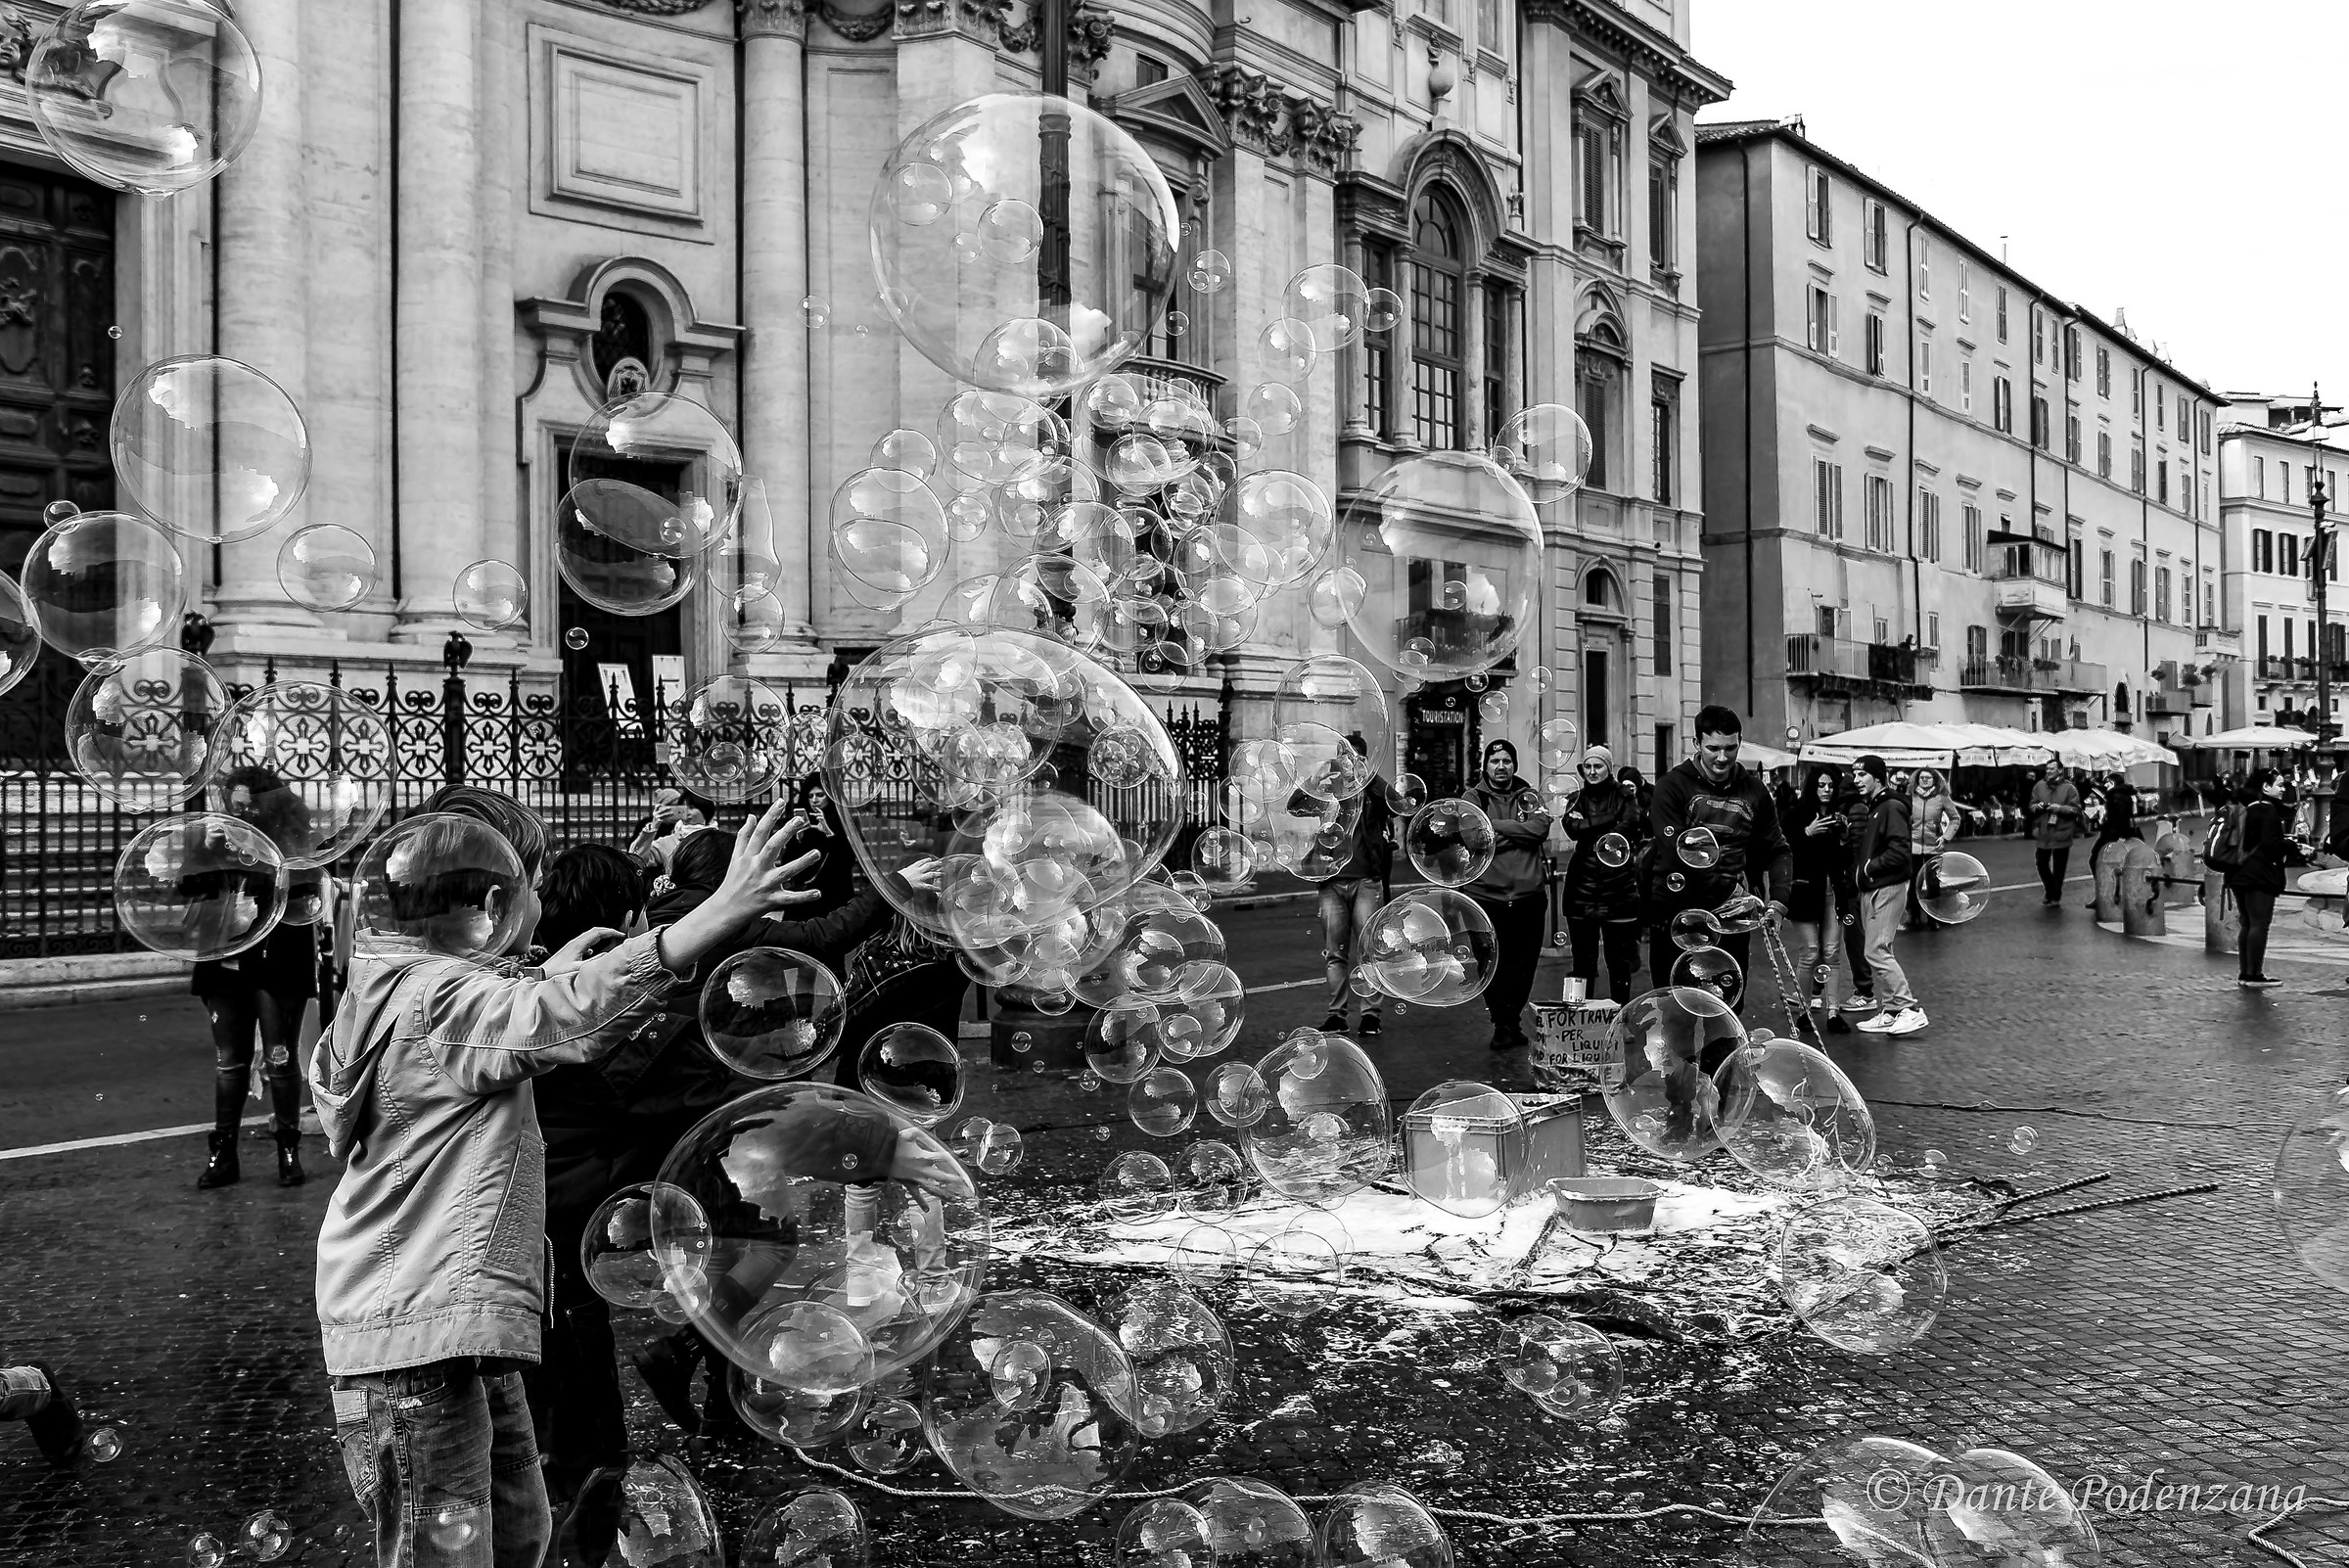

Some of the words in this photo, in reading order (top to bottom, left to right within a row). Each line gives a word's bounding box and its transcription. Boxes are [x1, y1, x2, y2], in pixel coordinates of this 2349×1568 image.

[1547, 1010, 1576, 1029] FOR
[1561, 1029, 1584, 1042] PER
[1549, 1053, 1568, 1066] FOR
